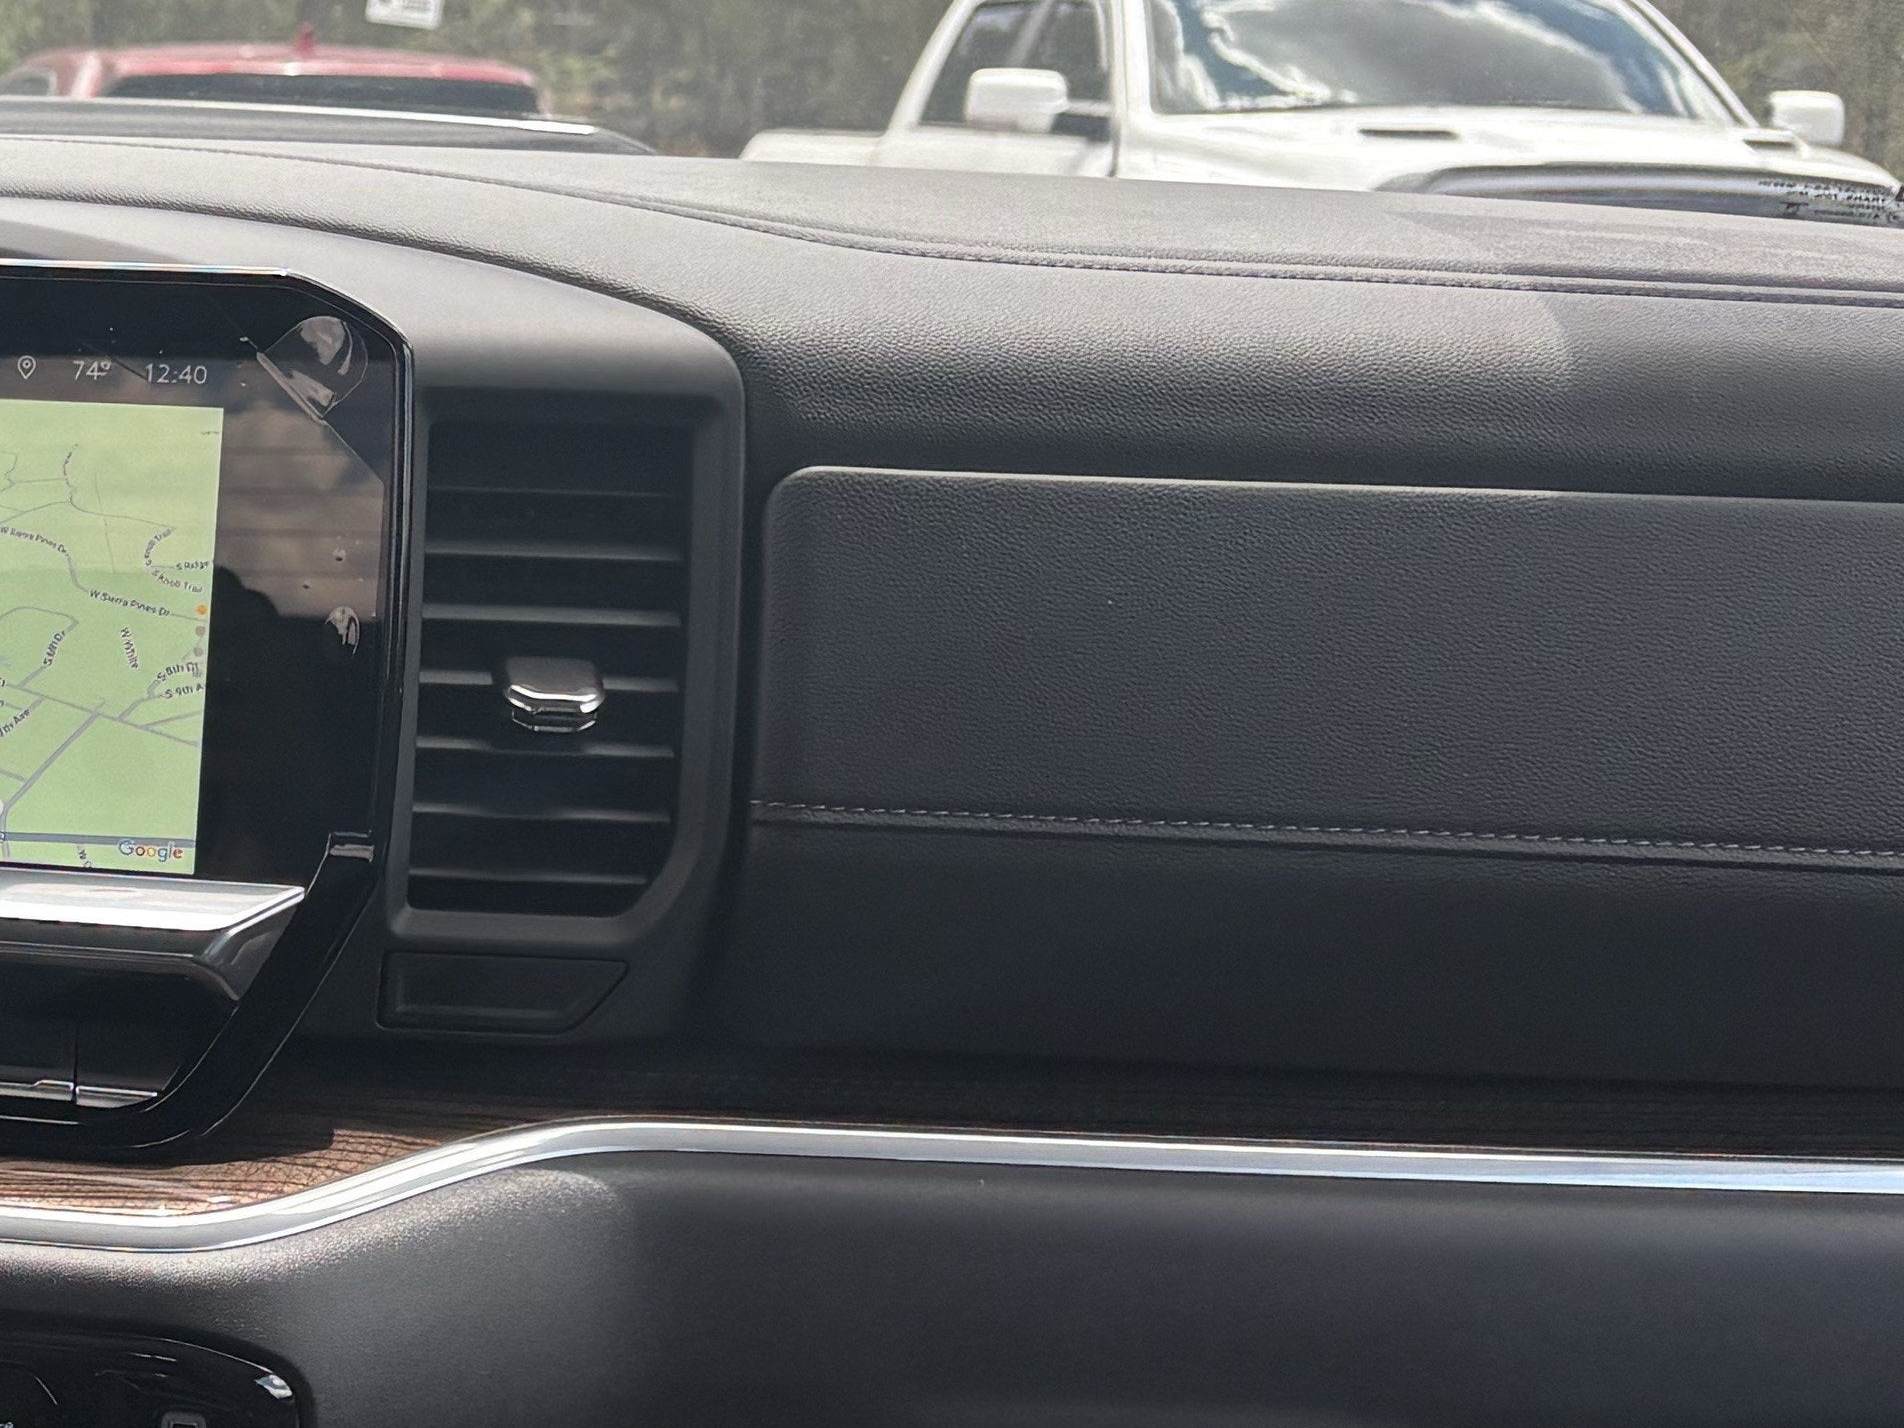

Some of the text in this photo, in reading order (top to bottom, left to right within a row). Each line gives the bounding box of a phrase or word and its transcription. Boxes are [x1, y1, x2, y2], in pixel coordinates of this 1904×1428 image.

[72, 360, 112, 381] 74°
[147, 363, 207, 384] 12:40
[118, 839, 184, 863] Google
